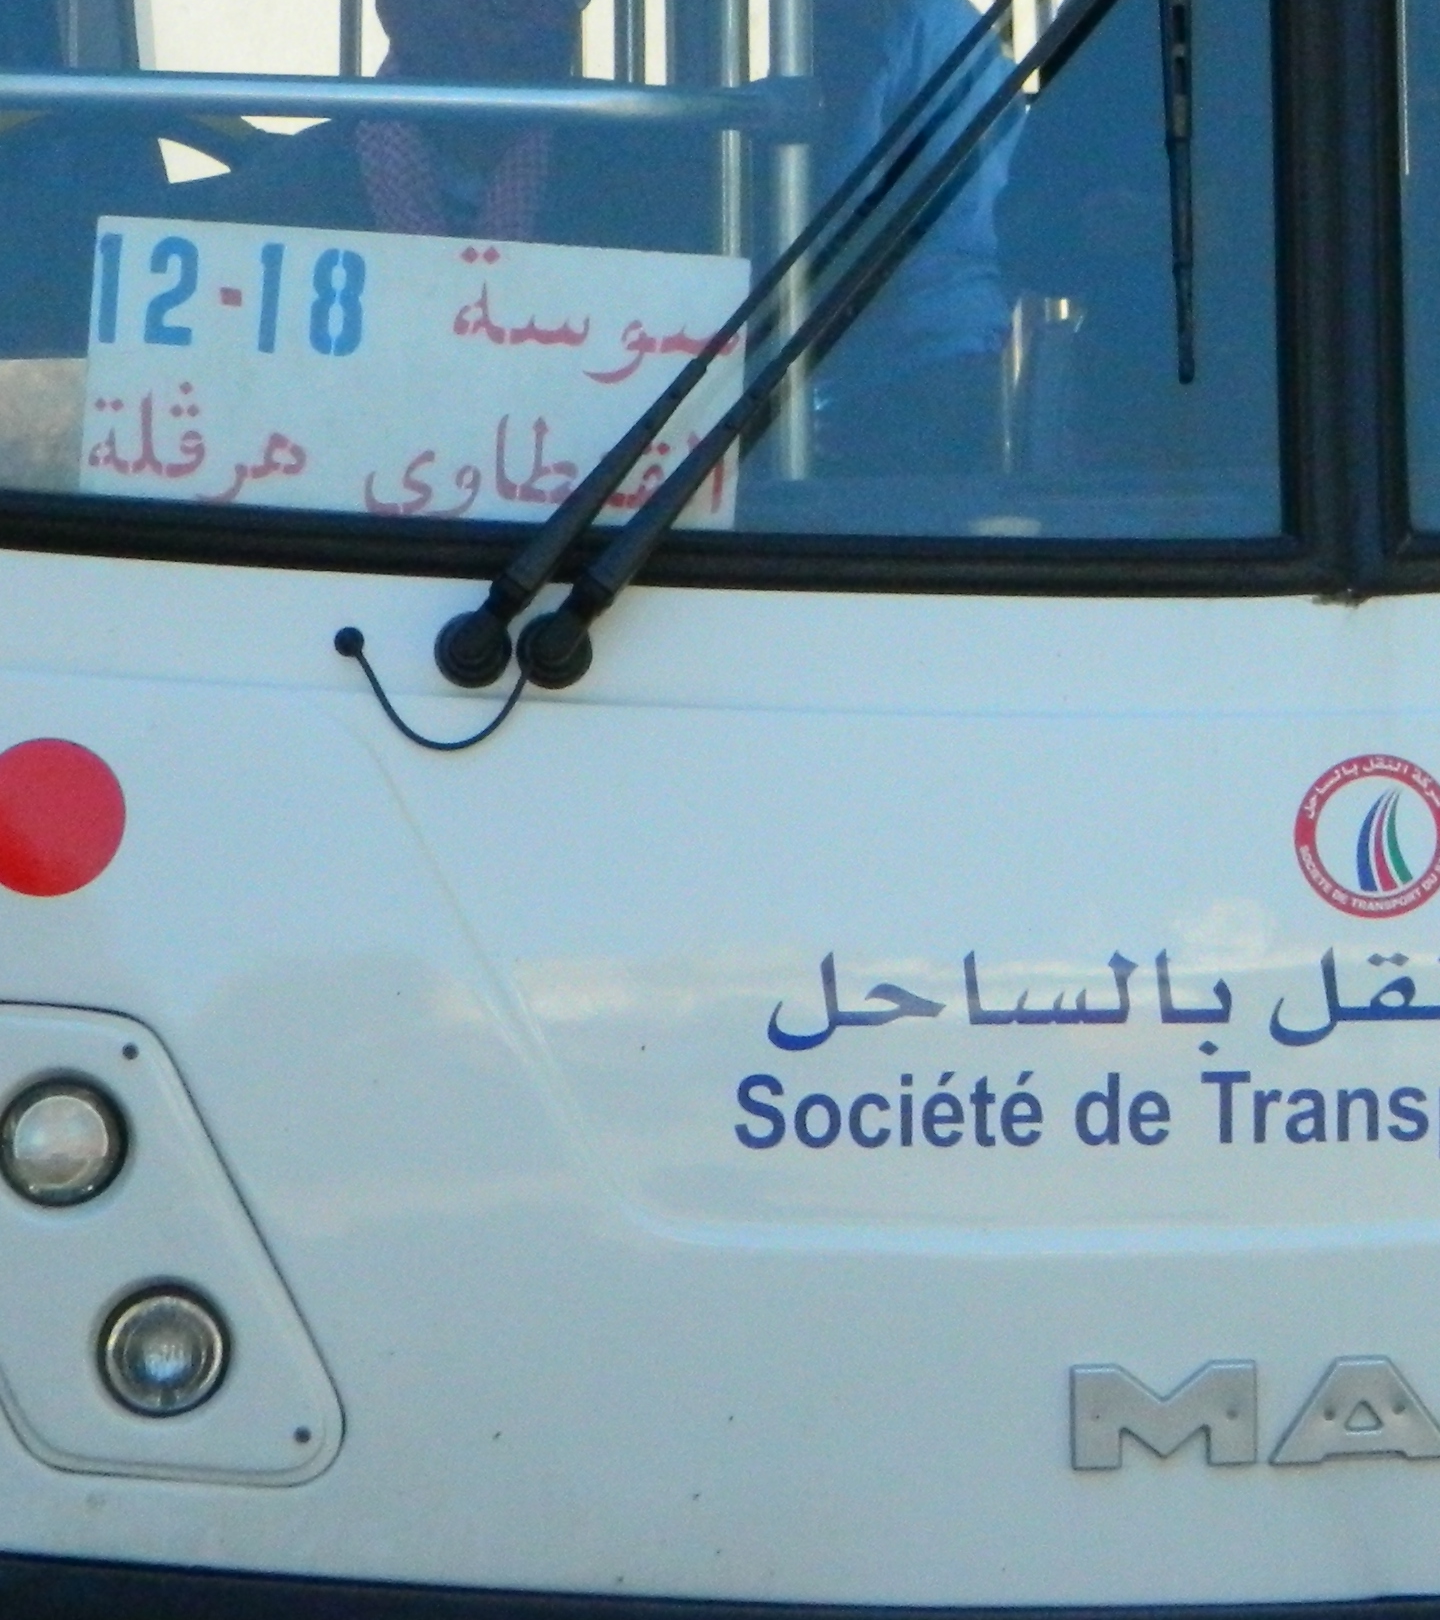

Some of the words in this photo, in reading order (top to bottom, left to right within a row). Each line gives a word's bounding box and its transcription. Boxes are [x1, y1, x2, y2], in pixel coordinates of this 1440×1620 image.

[97, 233, 366, 357] 12-18
[766, 948, 1233, 1057] بالساحل
[734, 1069, 1044, 1150] Société
[1073, 1071, 1172, 1147] de
